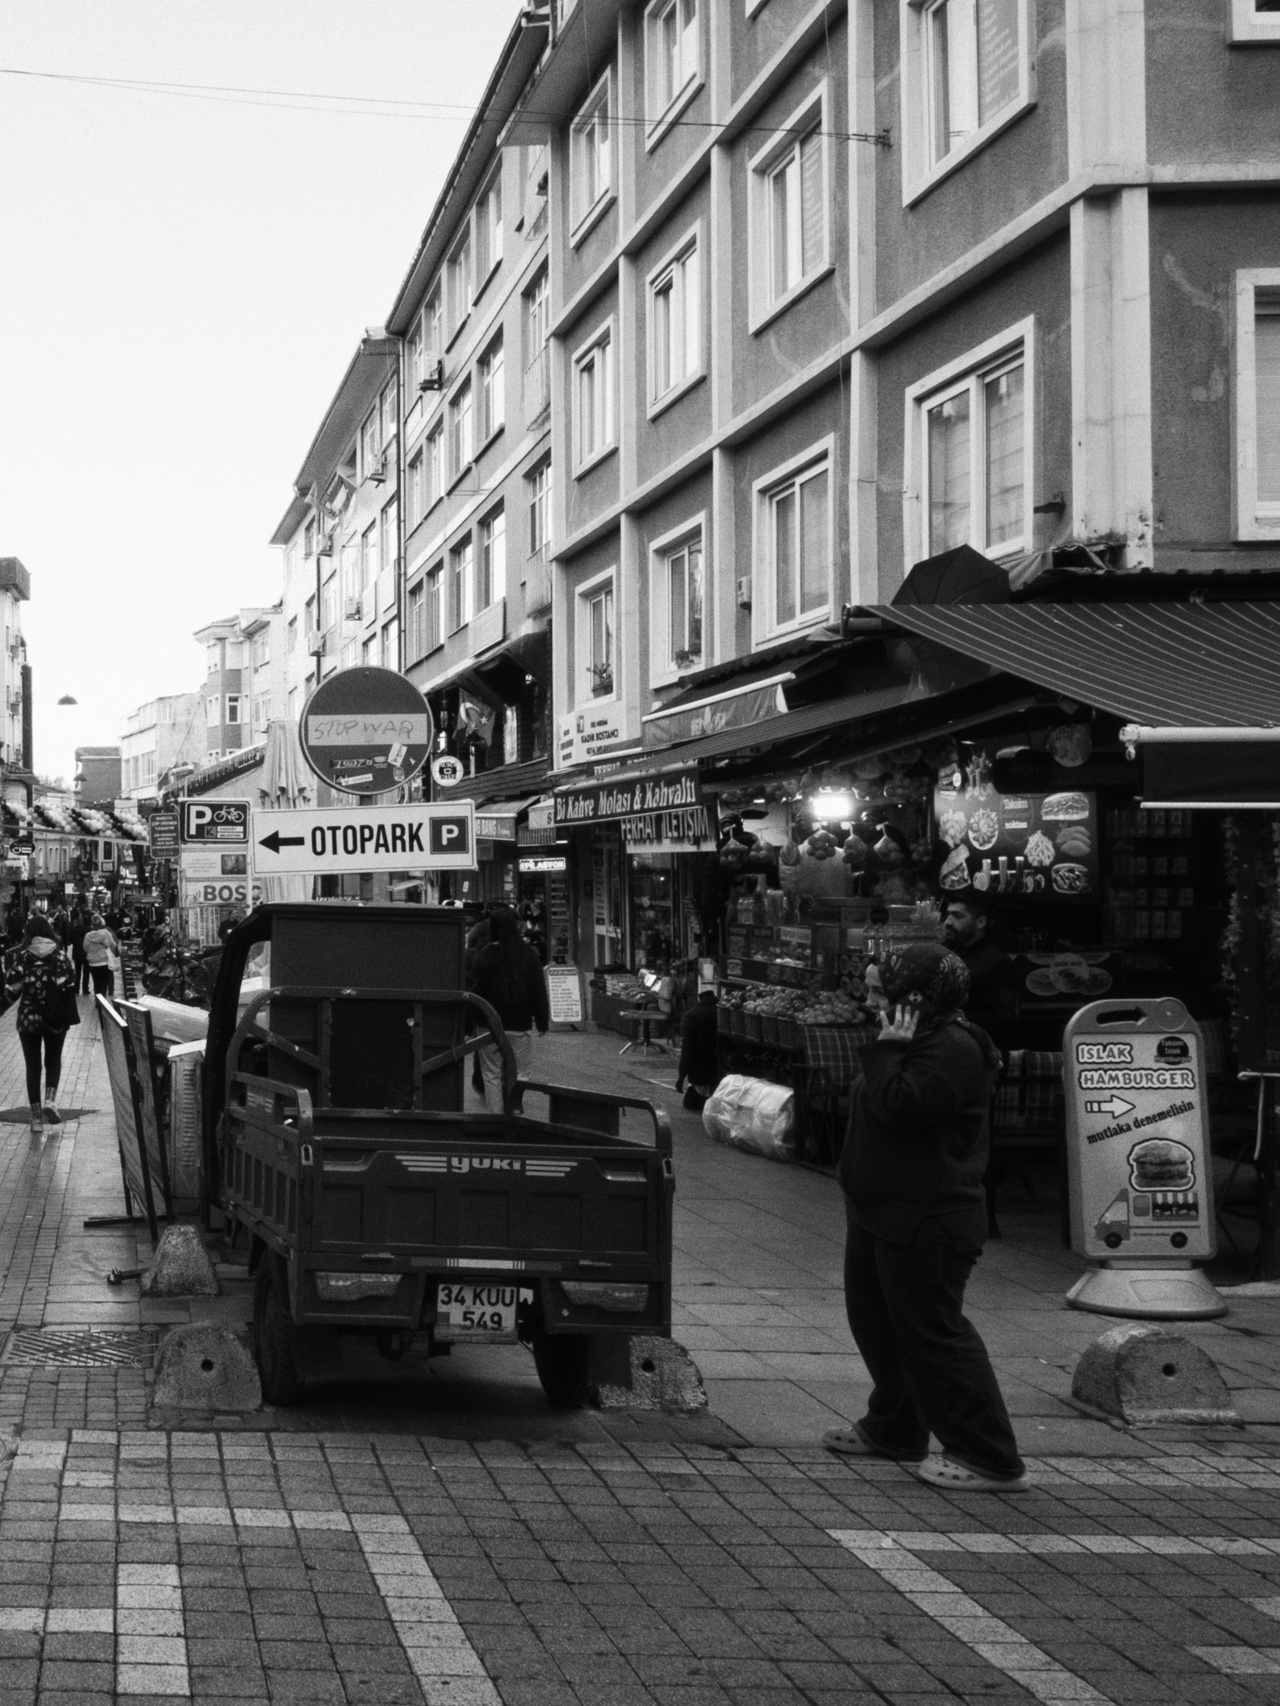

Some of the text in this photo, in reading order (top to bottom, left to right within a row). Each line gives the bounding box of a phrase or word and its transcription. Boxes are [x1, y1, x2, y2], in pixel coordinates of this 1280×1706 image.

[314, 719, 414, 740] STOP WAR
[556, 775, 696, 820] Bi Kahve Molası & Kahvaltı
[190, 805, 212, 835] P
[621, 814, 656, 841] FERHAT
[311, 822, 460, 857] OTOPARK P
[1079, 1044, 1131, 1063] ISLAK
[1082, 1070, 1194, 1088] HAMBURGER
[1087, 1100, 1195, 1145] mutlaka denemelisin
[450, 1157, 522, 1173] yuki
[440, 1286, 515, 1307] 34 KUU
[462, 1312, 503, 1331] 549
